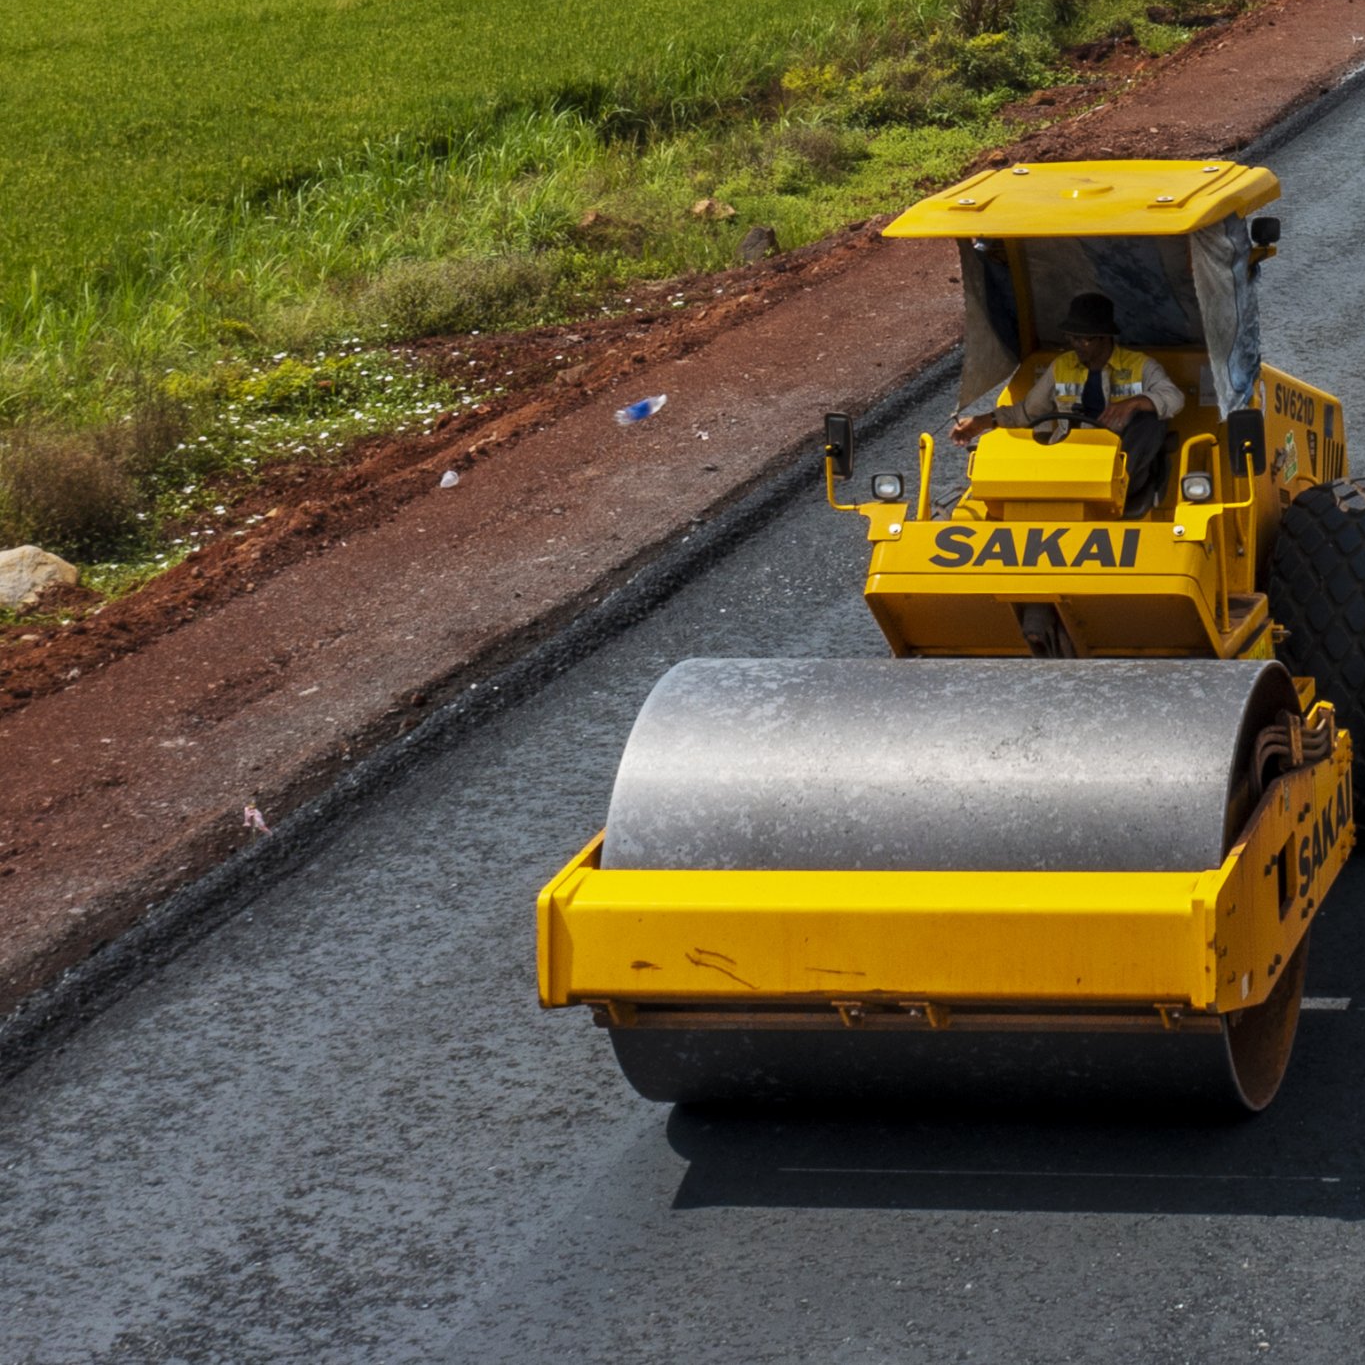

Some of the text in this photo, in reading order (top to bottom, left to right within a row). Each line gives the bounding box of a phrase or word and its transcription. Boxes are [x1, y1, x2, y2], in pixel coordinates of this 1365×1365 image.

[1274, 382, 1315, 427] SV621D
[928, 525, 1141, 568] SAKAI
[1299, 769, 1351, 898] SAKAI
